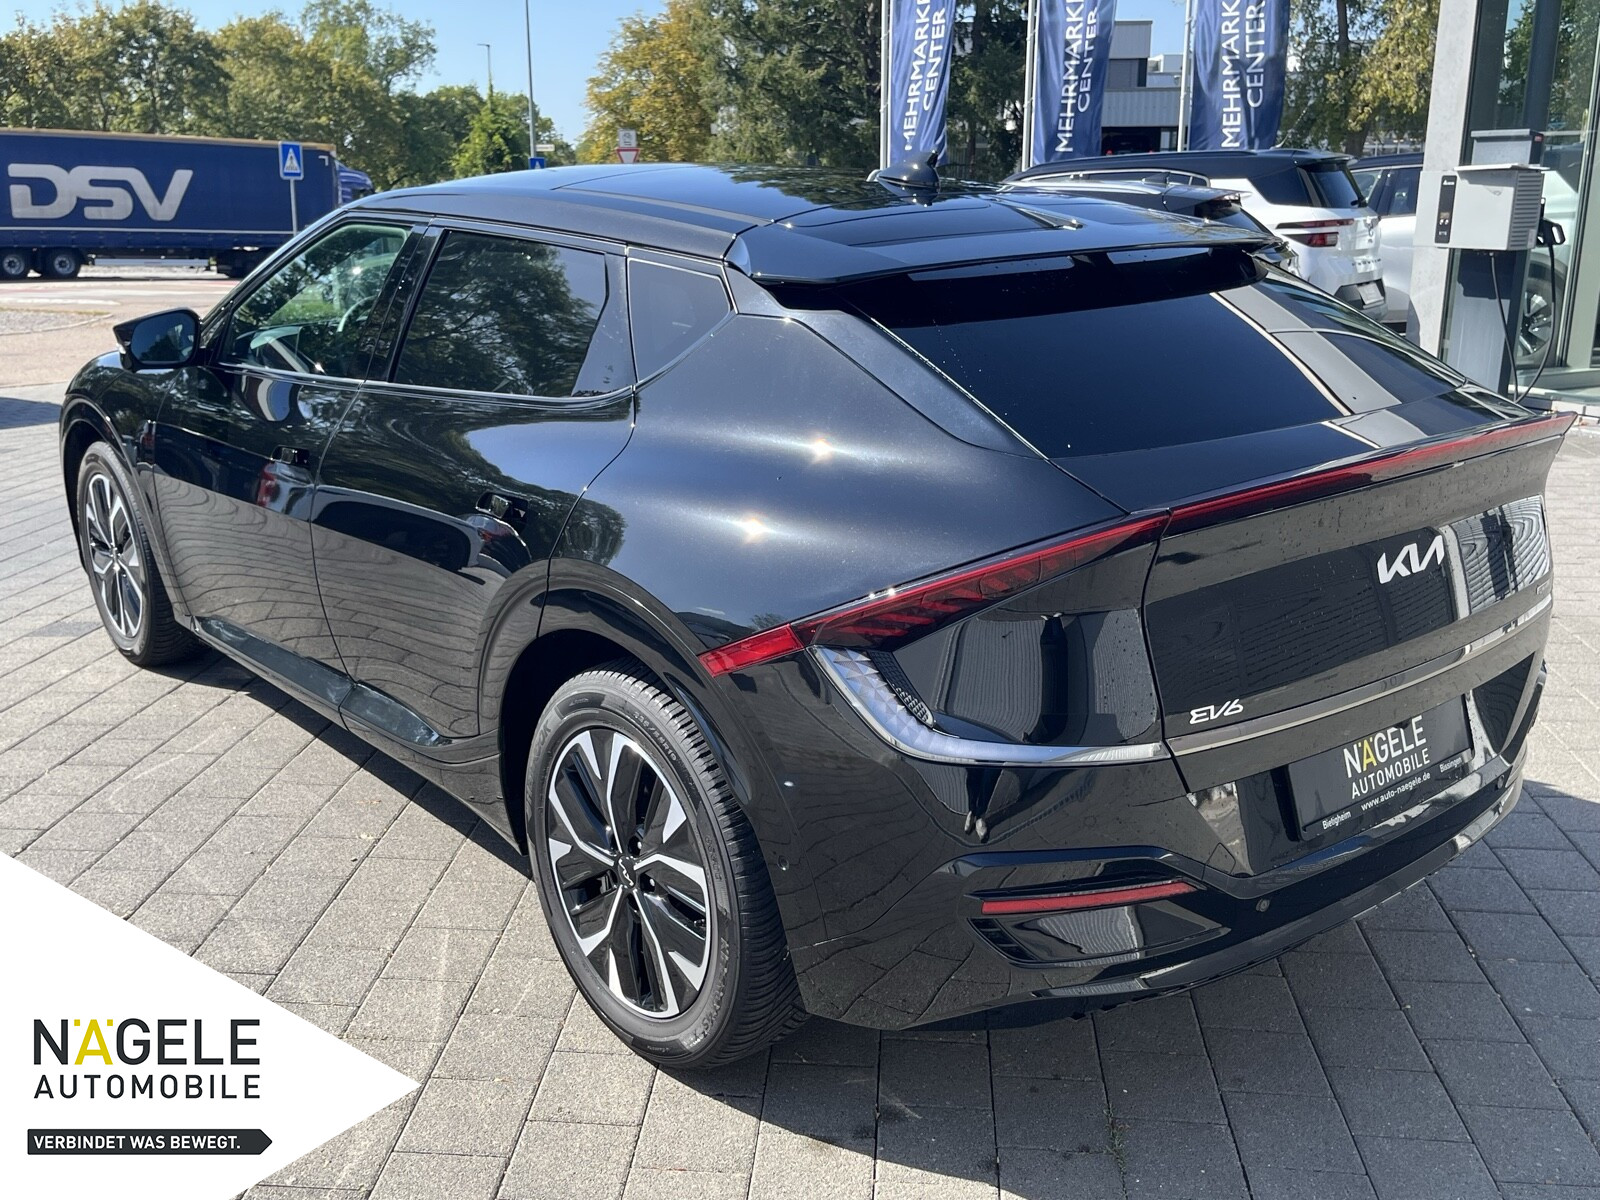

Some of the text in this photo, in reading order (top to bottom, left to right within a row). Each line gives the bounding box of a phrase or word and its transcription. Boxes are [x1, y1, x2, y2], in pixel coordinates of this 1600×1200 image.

[923, 7, 946, 111] CENTER
[1054, 0, 1085, 152] MEHRMARK
[1077, 6, 1098, 113] CENTER
[1245, 0, 1266, 108] CENTER
[7, 163, 194, 222] DSV
[1376, 534, 1445, 585] KIA
[1189, 698, 1244, 725] EV6
[1343, 715, 1427, 778] NÄGELE
[1351, 747, 1431, 800] AUTOMOBILE
[1439, 756, 1463, 773] Bissingen
[1360, 771, 1431, 812] www.auto-naegele.de
[1322, 810, 1352, 830] Bietigheim
